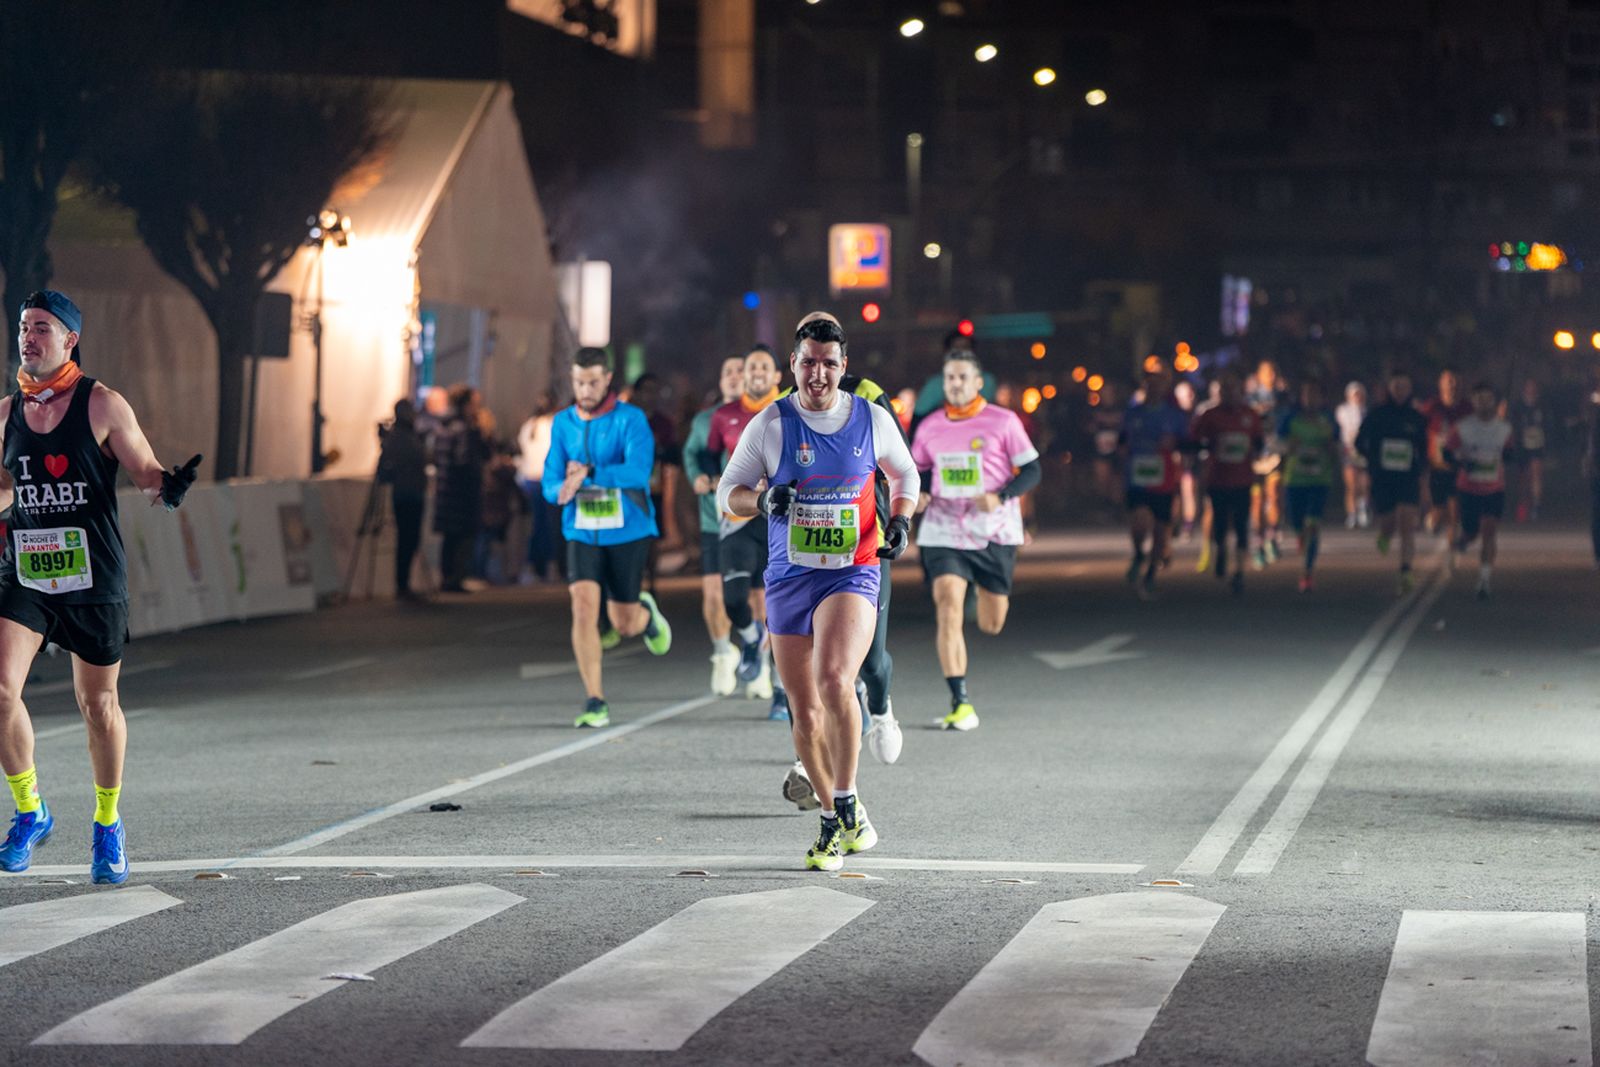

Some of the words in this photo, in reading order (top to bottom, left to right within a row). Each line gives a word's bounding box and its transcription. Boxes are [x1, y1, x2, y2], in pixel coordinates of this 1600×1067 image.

[18, 455, 32, 480] I
[16, 481, 89, 508] KRABI
[799, 492, 838, 501] MANCHA
[839, 491, 861, 500] REAL
[25, 505, 77, 515] THAILAND
[805, 511, 825, 519] NOCHE
[796, 518, 810, 526] SAN
[29, 536, 49, 544] NOCHE
[804, 528, 844, 547] 7143
[23, 544, 36, 552] SAN
[30, 550, 74, 573] 8997
